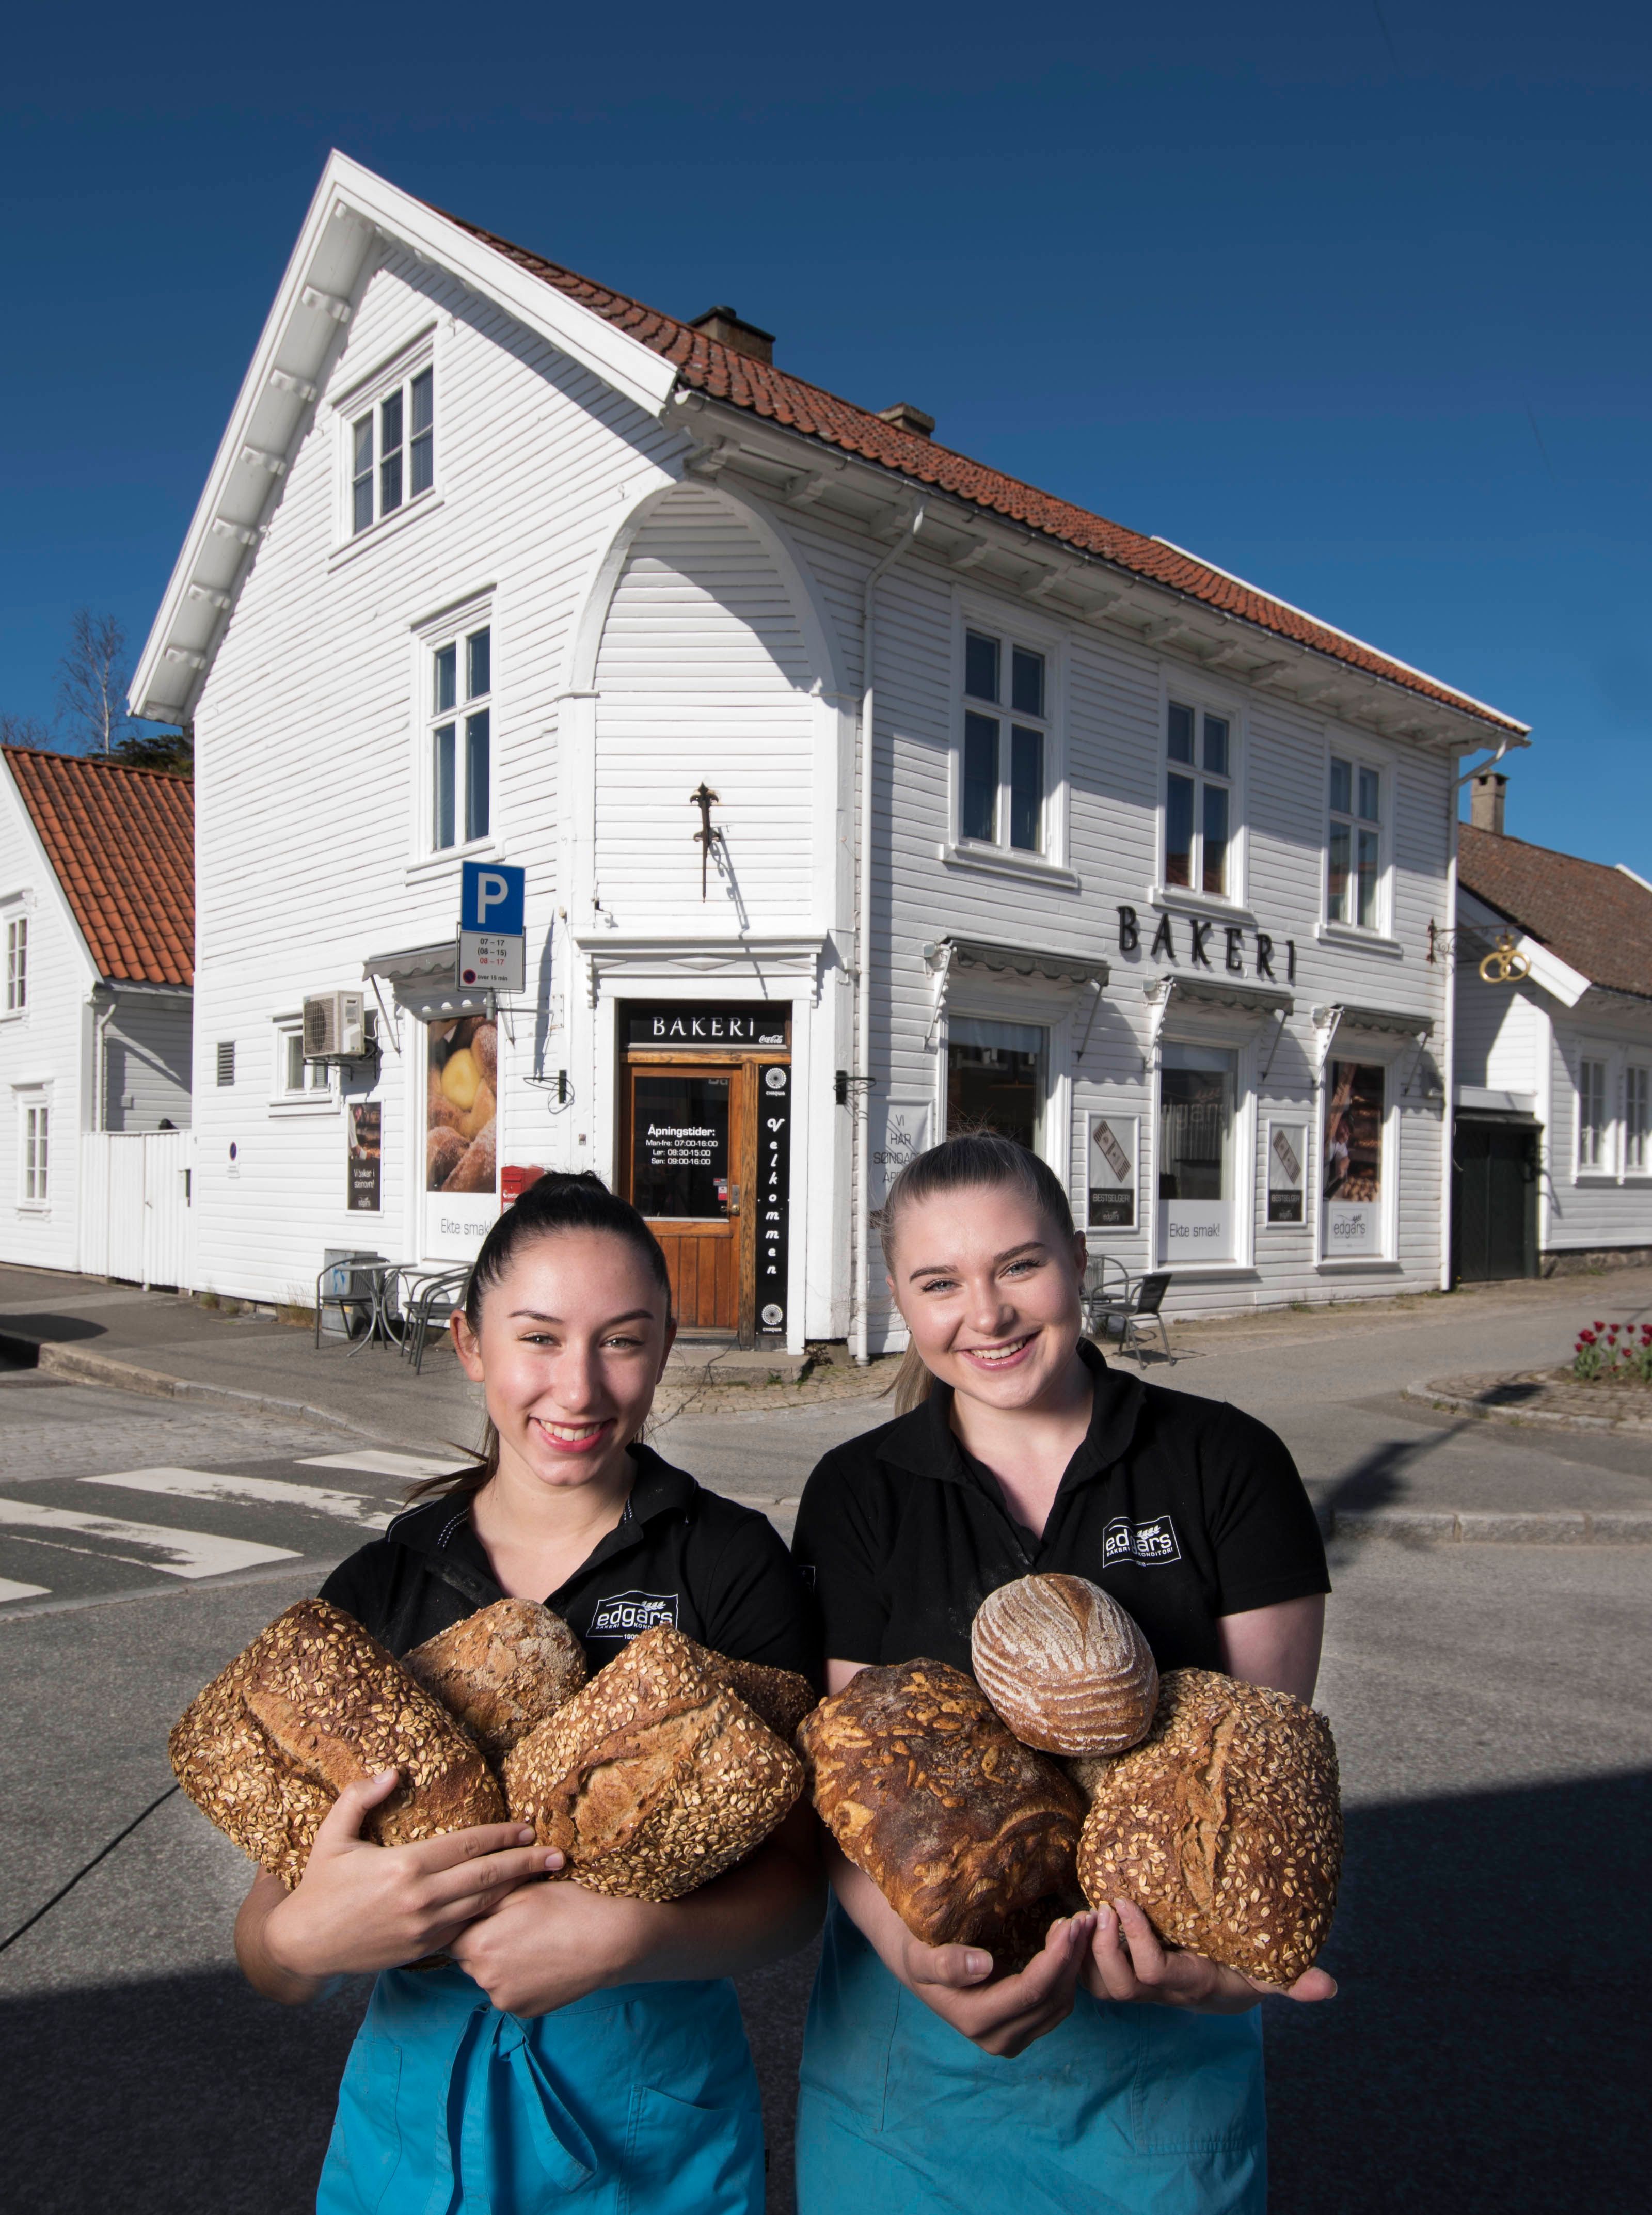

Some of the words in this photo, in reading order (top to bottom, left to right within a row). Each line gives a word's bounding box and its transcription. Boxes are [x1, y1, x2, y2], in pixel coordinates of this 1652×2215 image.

[478, 872, 509, 924] P
[1116, 905, 1294, 982] BAKERI
[497, 949, 506, 957] 15)
[652, 1017, 755, 1036] BAKERI
[896, 1115, 904, 1126] VI
[647, 1123, 716, 1138] Åpningstider:
[891, 1133, 911, 1145] HAR
[358, 1168, 372, 1177] baker
[765, 1118, 785, 1274] Velkommen
[1093, 1193, 1130, 1203] BESTSELGER!
[441, 1218, 460, 1235] Ekte
[1170, 1223, 1189, 1237] Ekte
[1193, 1224, 1220, 1237] smak!
[1334, 1219, 1365, 1238] edgars
[1107, 1546, 1130, 1557] BAKERI
[1138, 1547, 1173, 1557] KONDITORI
[597, 1605, 673, 1627] edgars
